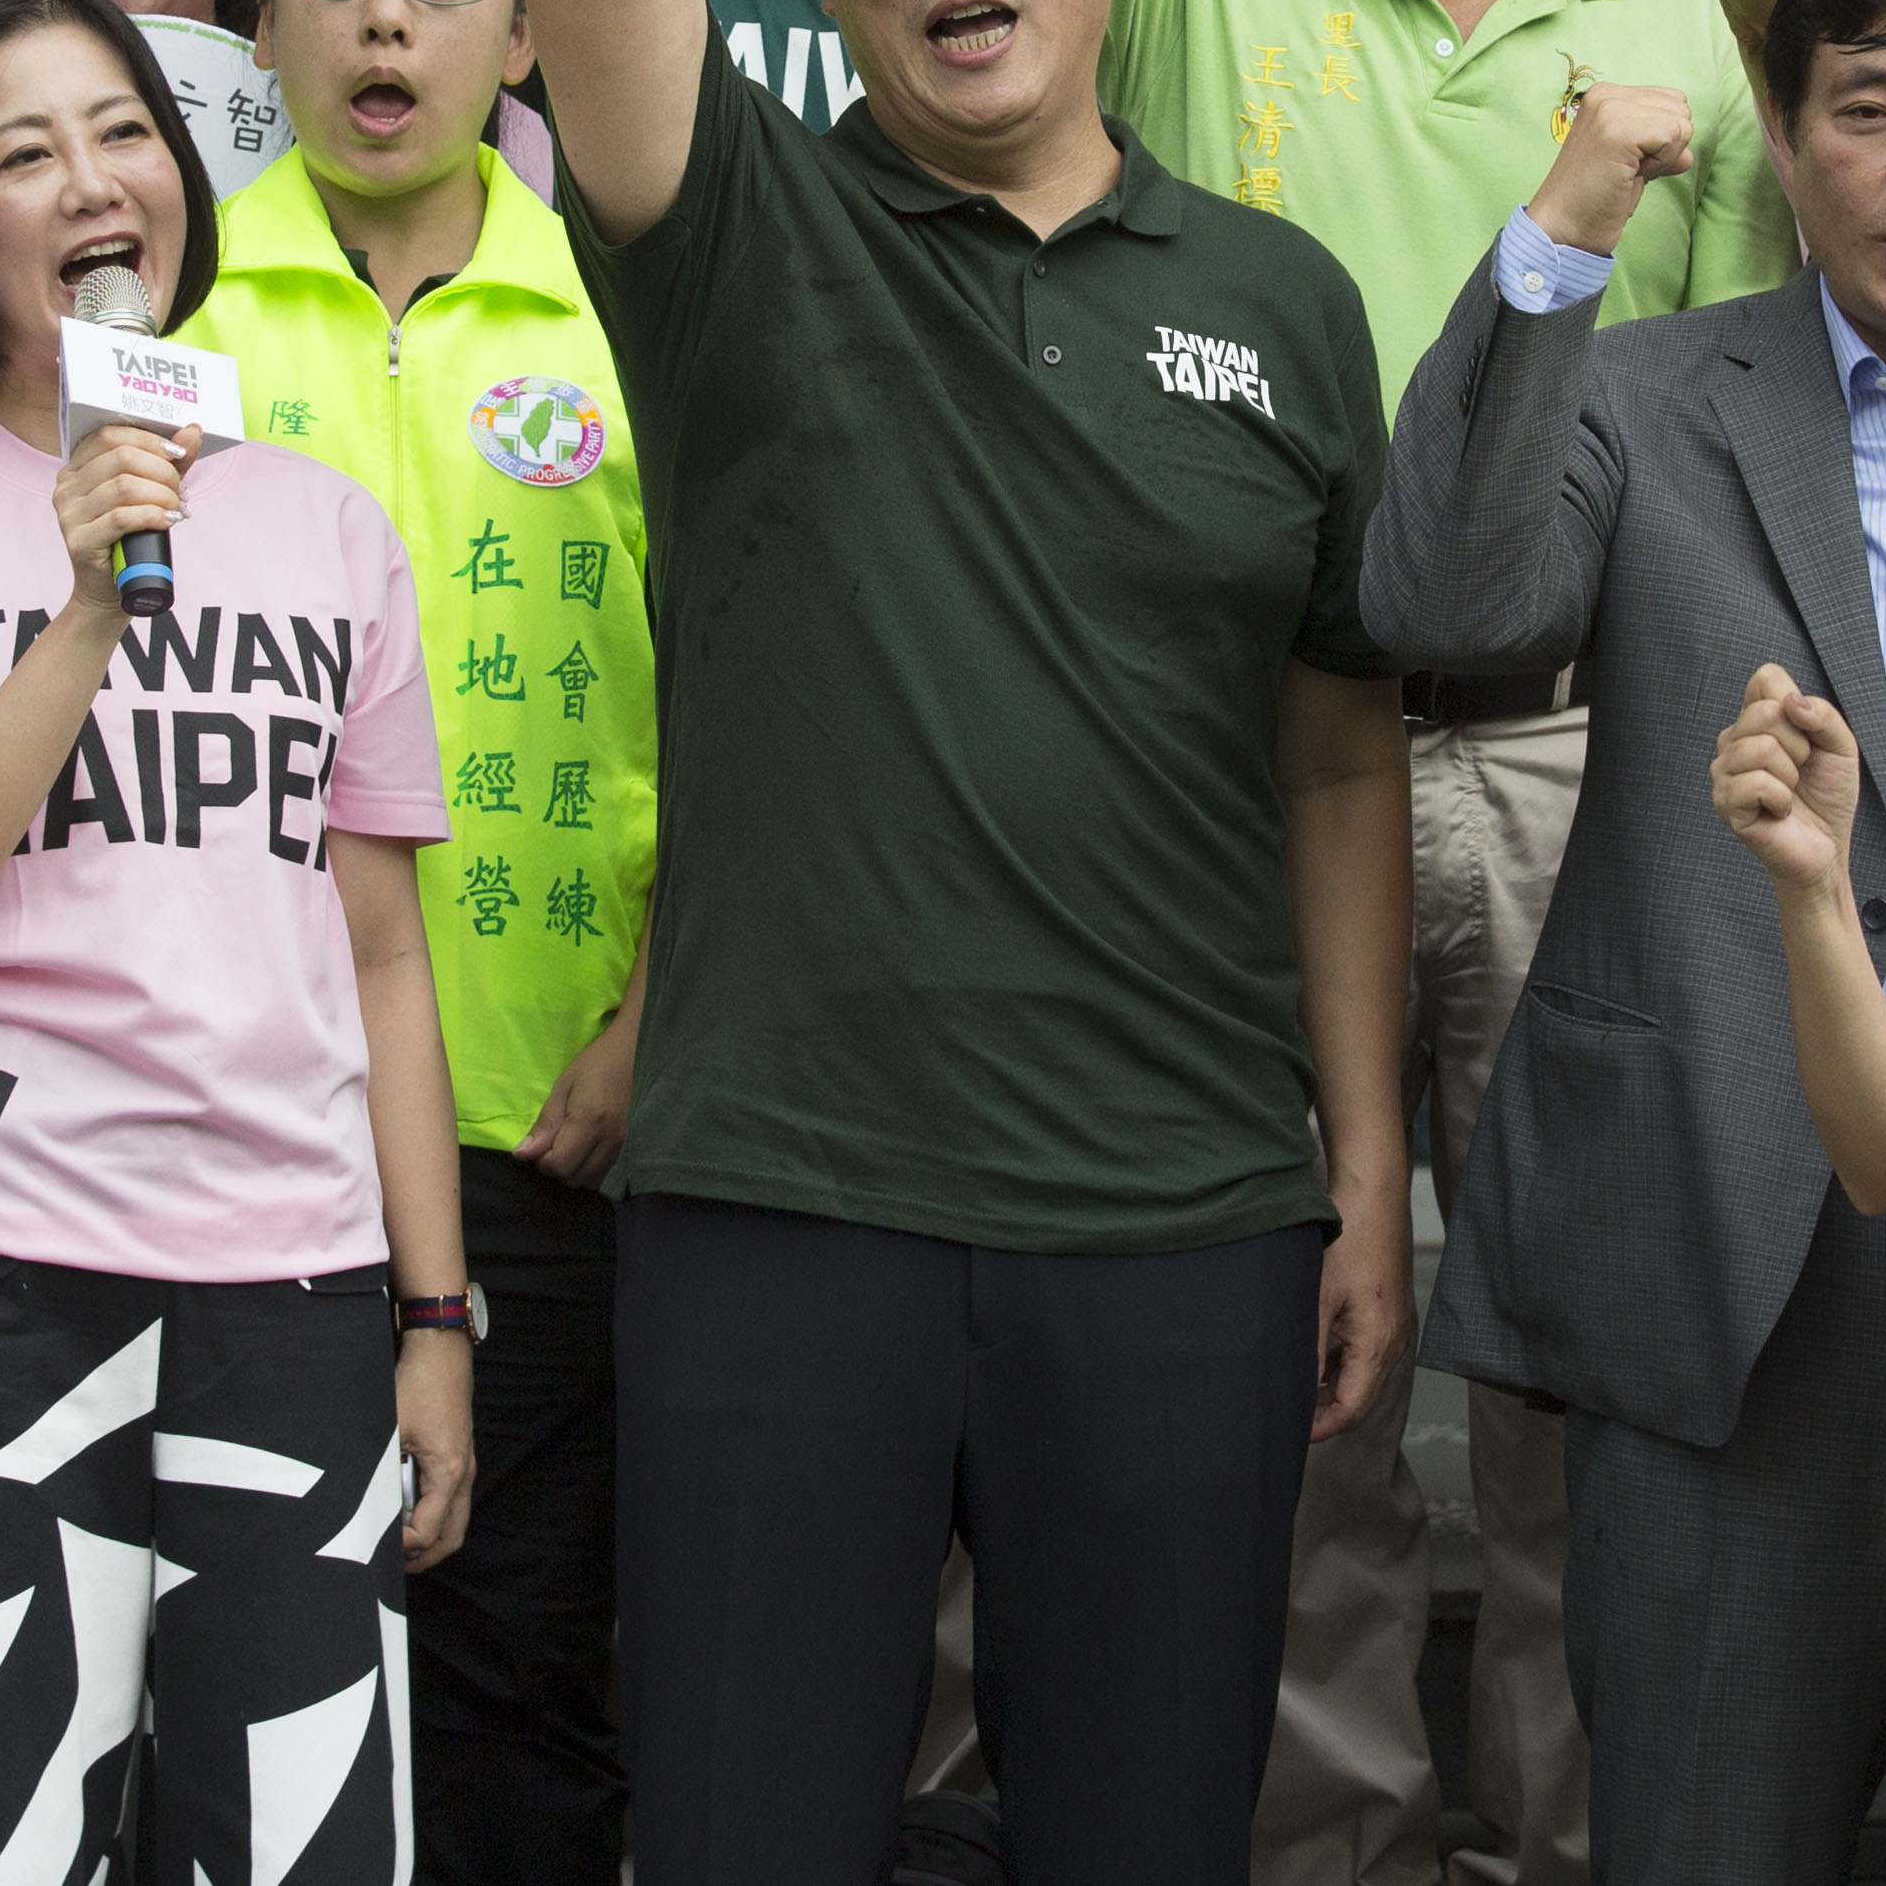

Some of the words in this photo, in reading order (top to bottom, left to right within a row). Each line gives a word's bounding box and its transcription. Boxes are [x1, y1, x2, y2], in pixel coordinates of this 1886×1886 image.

[1313, 12, 1363, 103] 里長
[1146, 351, 1276, 421] TAIPEI
[1154, 325, 1259, 376] TAIWAN
[268, 397, 319, 437] 隆
[450, 518, 526, 938] 在地經營
[542, 539, 612, 948] 國會歷練
